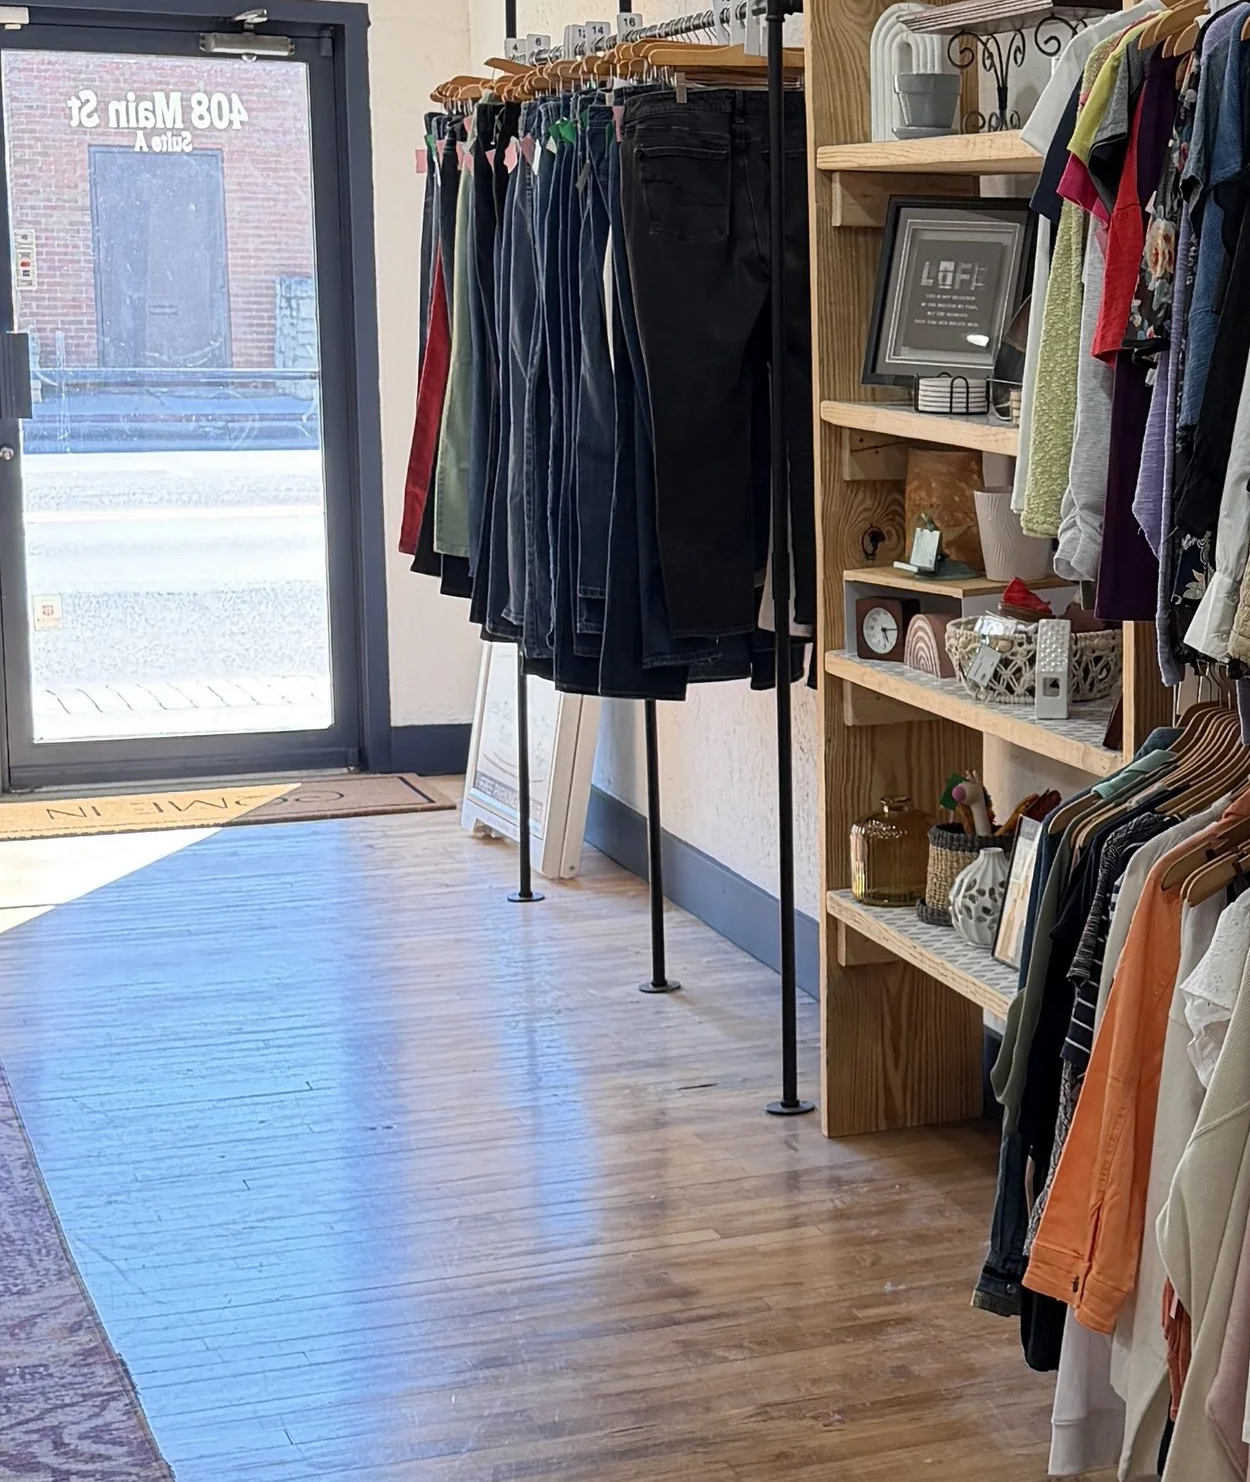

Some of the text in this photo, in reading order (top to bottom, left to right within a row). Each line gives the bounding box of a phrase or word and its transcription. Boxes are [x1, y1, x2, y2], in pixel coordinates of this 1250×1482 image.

[623, 17, 635, 27] 16
[592, 26, 603, 35] 14
[535, 37, 541, 46] 6
[512, 43, 518, 52] 4
